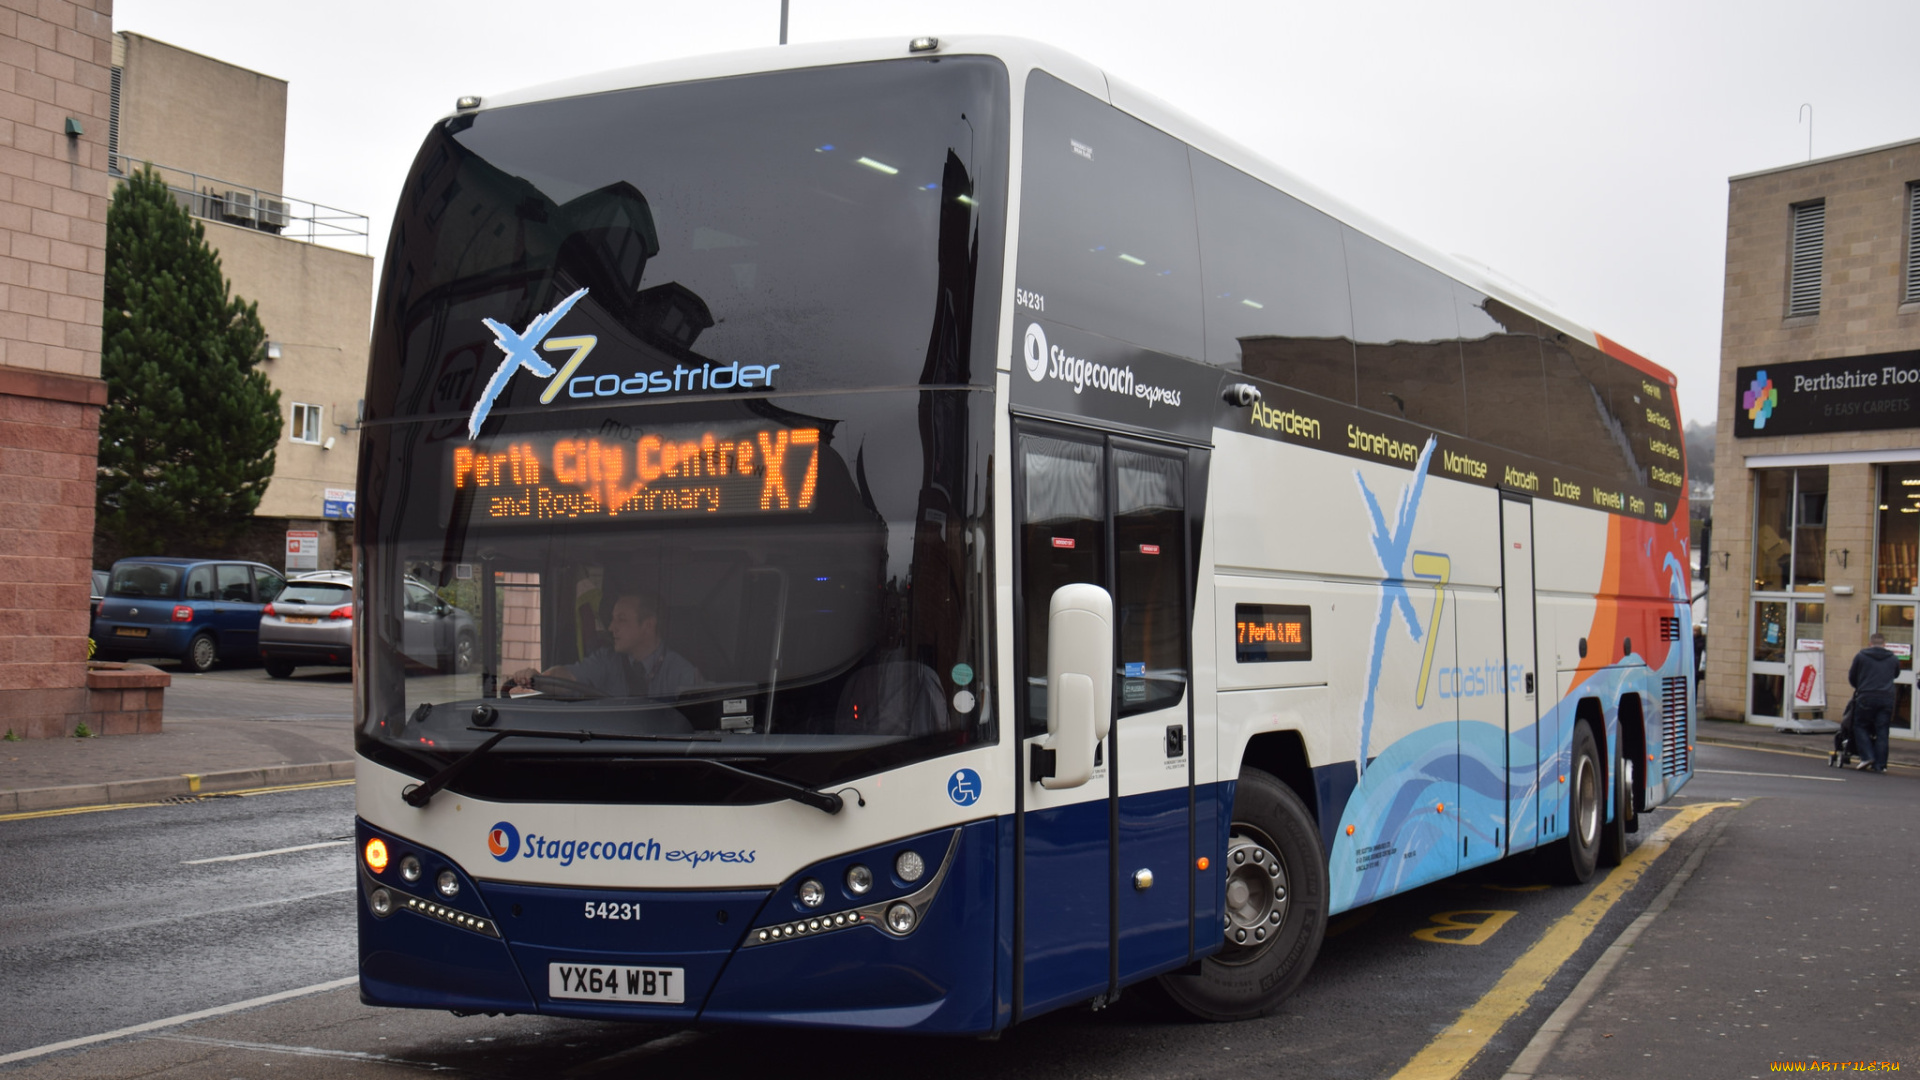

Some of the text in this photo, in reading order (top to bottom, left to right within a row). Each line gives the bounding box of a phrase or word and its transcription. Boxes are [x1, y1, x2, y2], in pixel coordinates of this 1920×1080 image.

[1016, 287, 1045, 312] 54231
[568, 360, 781, 399] coastrider
[1049, 343, 1182, 409] Stagecoach express
[1793, 370, 1878, 393] Perthshire
[1251, 401, 1321, 441] Aberdeen
[1835, 402, 1860, 416] EASY
[1862, 398, 1910, 414] CARPETS
[1347, 423, 1419, 463] Stonehaven
[454, 433, 753, 488] Perth City Centre
[758, 428, 821, 510] X7
[1443, 449, 1488, 480] Montrose
[1504, 464, 1539, 492] Arbroath
[1553, 476, 1581, 500] Dundee
[489, 488, 530, 518] and
[537, 486, 601, 519] Royal
[1248, 621, 1276, 644] Perth
[1277, 622, 1285, 643] &
[1437, 657, 1527, 699] coastrider
[523, 833, 756, 869] Stagecoach express
[584, 901, 642, 921] 54231
[559, 966, 673, 997] YX64 WBT
